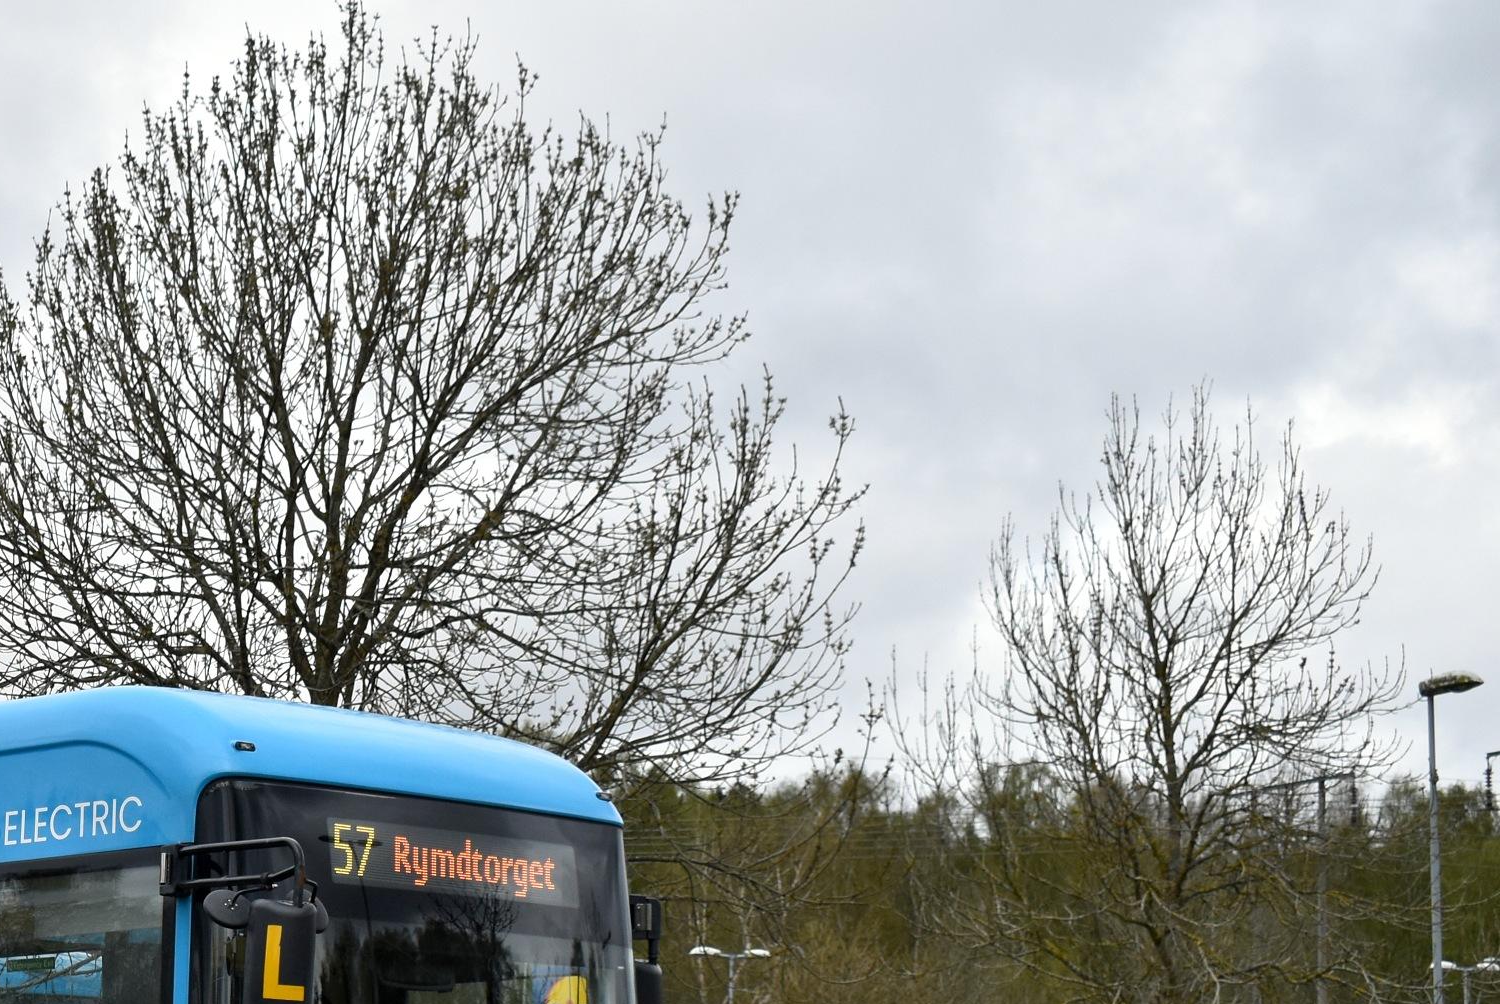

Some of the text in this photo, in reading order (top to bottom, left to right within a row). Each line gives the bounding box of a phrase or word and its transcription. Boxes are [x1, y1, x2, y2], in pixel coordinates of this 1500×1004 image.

[3, 796, 143, 846] ELECTRIC
[333, 823, 555, 898] 57 Rymdtorget
[262, 924, 305, 1002] L
